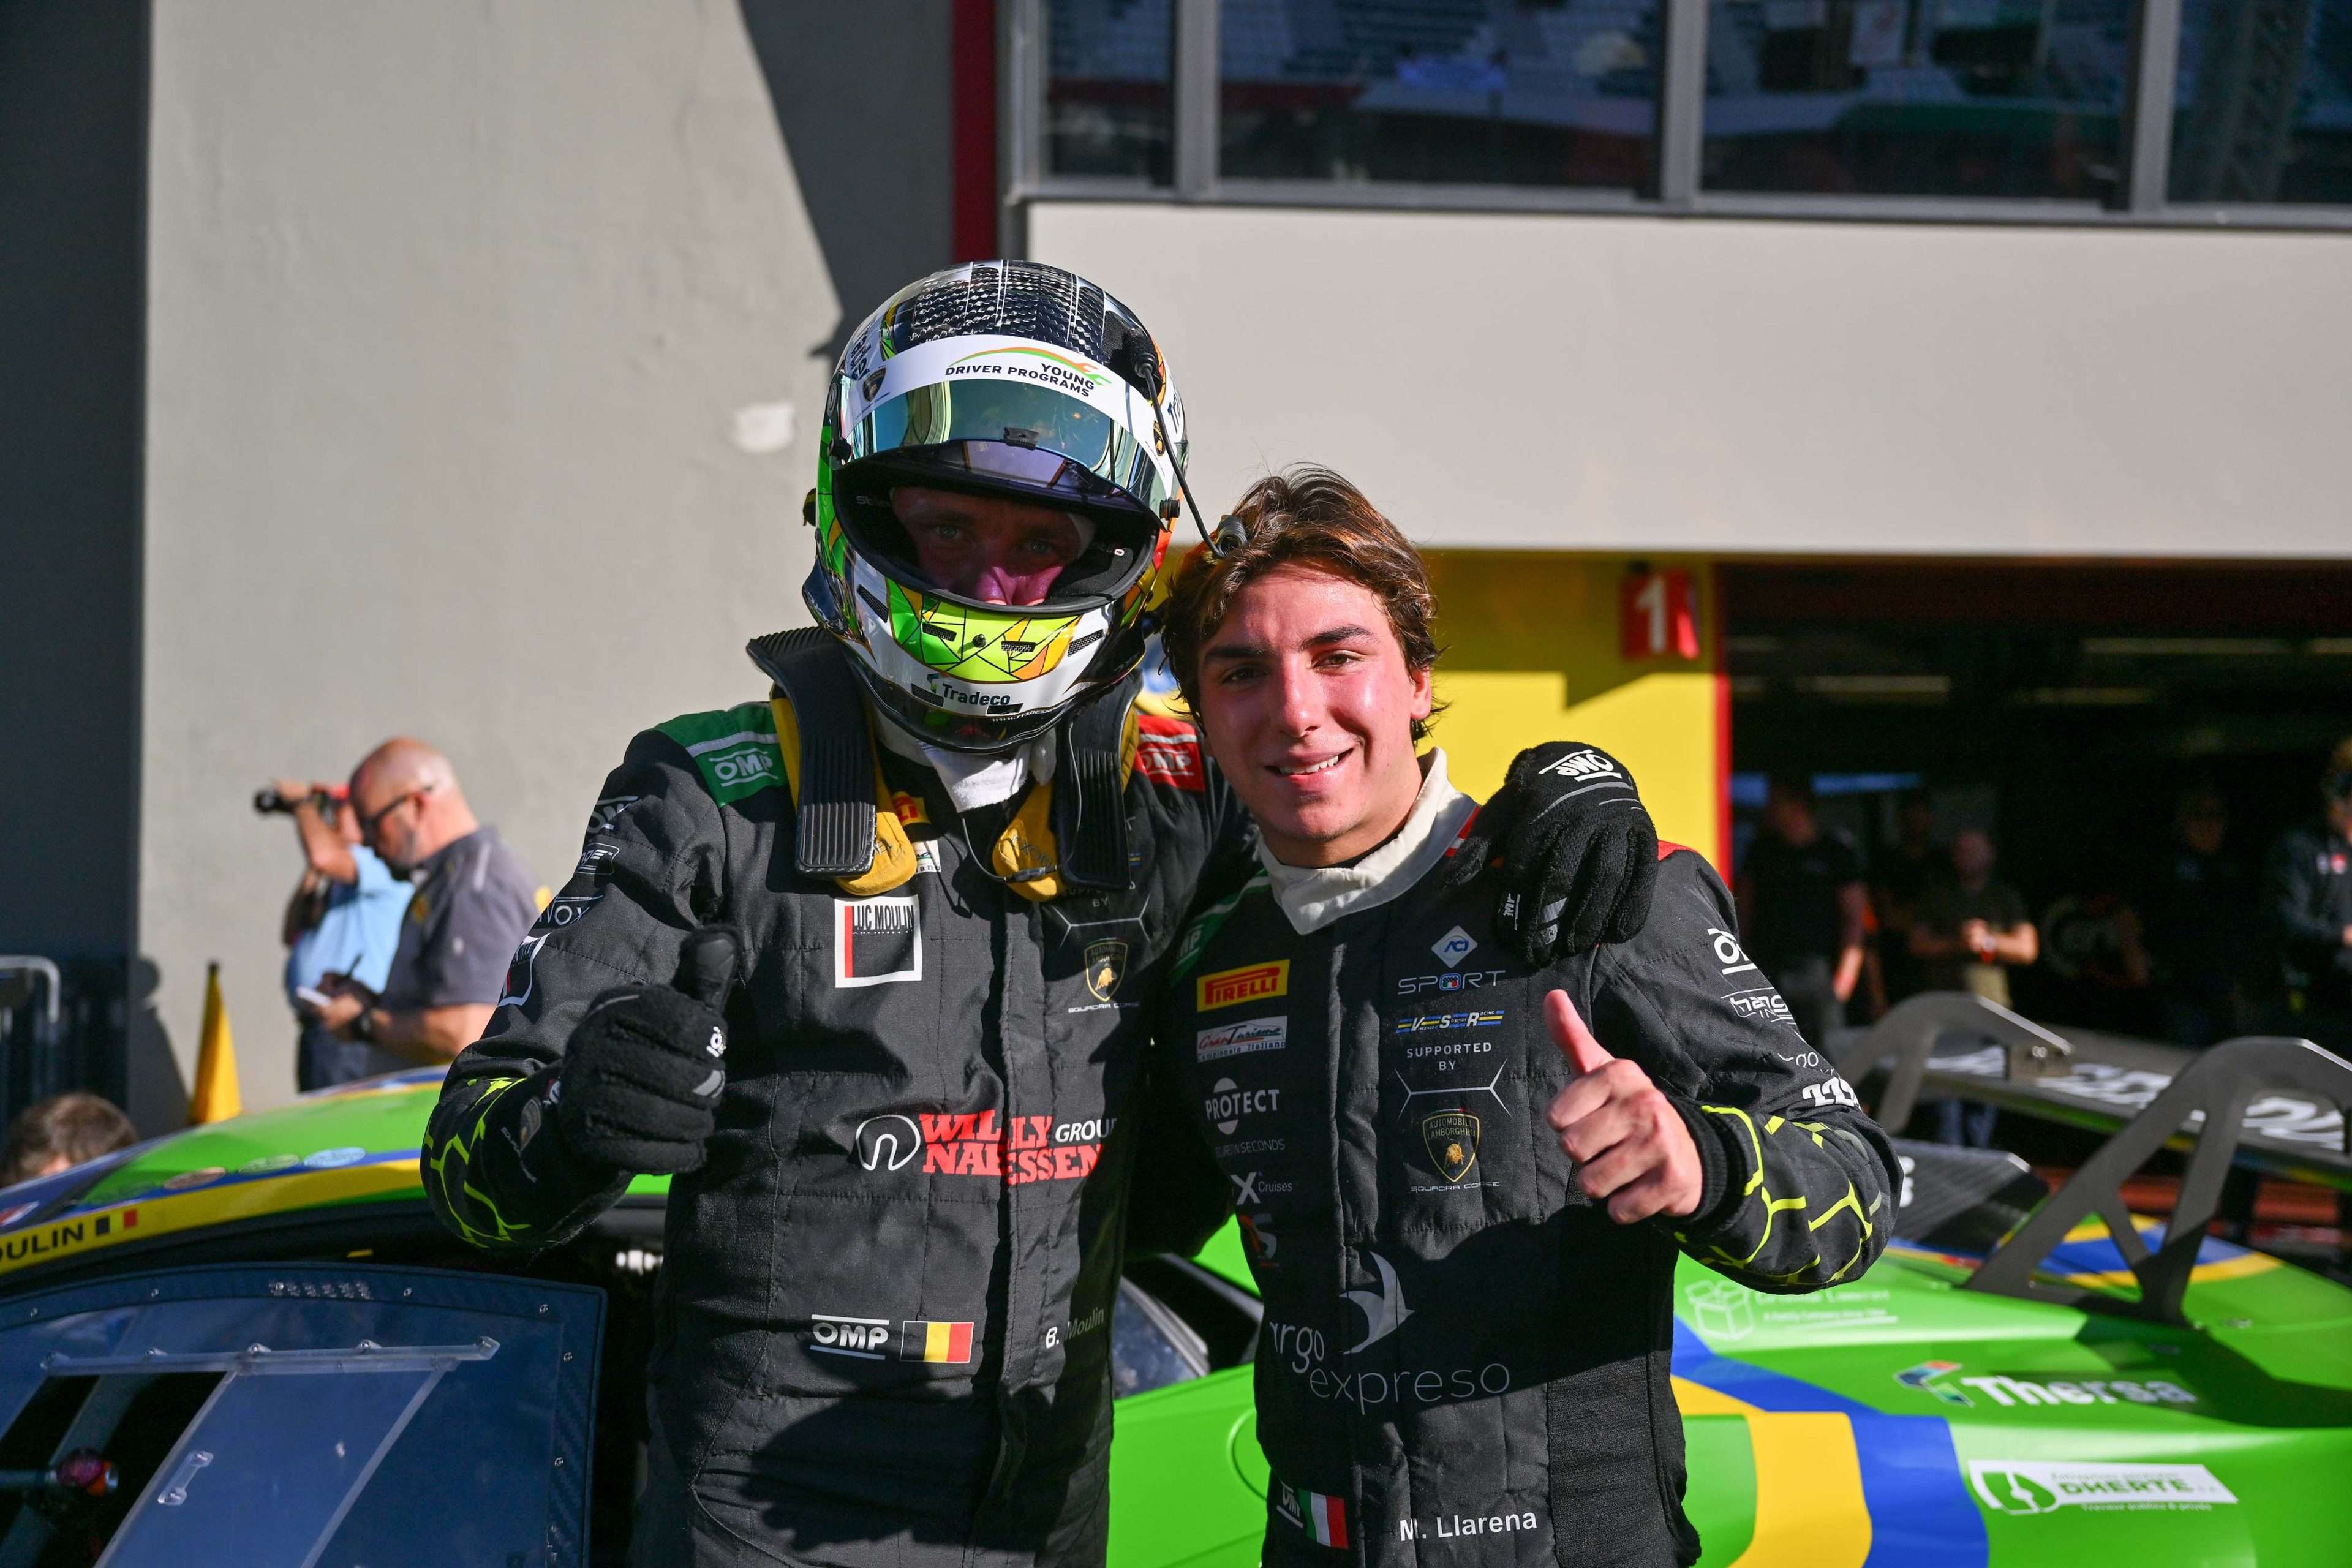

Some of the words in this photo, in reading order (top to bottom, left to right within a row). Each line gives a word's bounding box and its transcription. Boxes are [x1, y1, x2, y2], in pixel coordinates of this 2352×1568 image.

[945, 365, 1002, 375] DRIVER
[1008, 367, 1090, 397] PROGRAMS
[1041, 363, 1094, 390] YOUNG
[1635, 579, 1666, 652] 1
[943, 684, 1011, 705] Tradeco
[715, 754, 773, 780] OMP
[1555, 753, 1614, 776] OMP
[1092, 897, 1108, 907] BY
[852, 905, 872, 930] LUC
[875, 905, 914, 930] MOULIN
[1444, 940, 1469, 953] ACI
[1205, 967, 1281, 1005] PIRELLI
[1398, 970, 1506, 995] SPORT
[1068, 1003, 1111, 1013] SQUADRA
[1406, 1042, 1492, 1058] SUPPORTED
[1439, 1061, 1456, 1071] BY
[1205, 1089, 1280, 1120] PROTECT
[919, 1109, 1052, 1150] WILLY
[1258, 1180, 1293, 1193] Cruises
[0, 1223, 84, 1261] ULIN
[813, 1322, 889, 1351] OMP
[1046, 1326, 1060, 1349] B.
[1066, 1306, 1104, 1340] Moulin
[1310, 1363, 1510, 1415] expreso
[1959, 1375, 2198, 1407] Thersa
[1400, 1518, 1427, 1542] M.
[1437, 1512, 1537, 1538] Llarena
